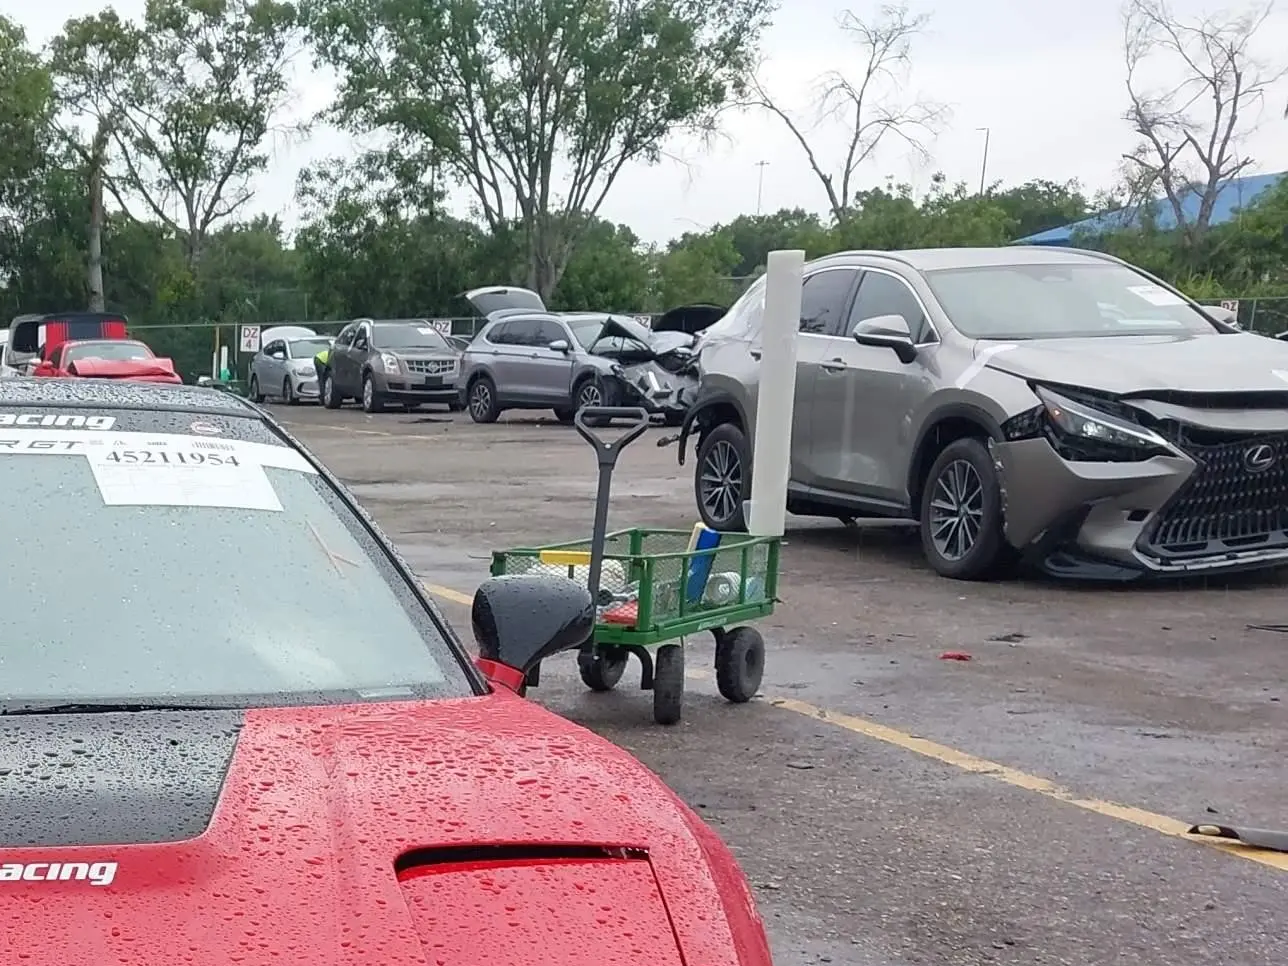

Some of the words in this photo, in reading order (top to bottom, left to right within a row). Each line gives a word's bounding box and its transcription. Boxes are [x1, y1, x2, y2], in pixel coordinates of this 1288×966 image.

[243, 327, 258, 338] DZ
[245, 339, 252, 349] 4
[26, 440, 85, 449] GT
[105, 450, 240, 467] 45211954
